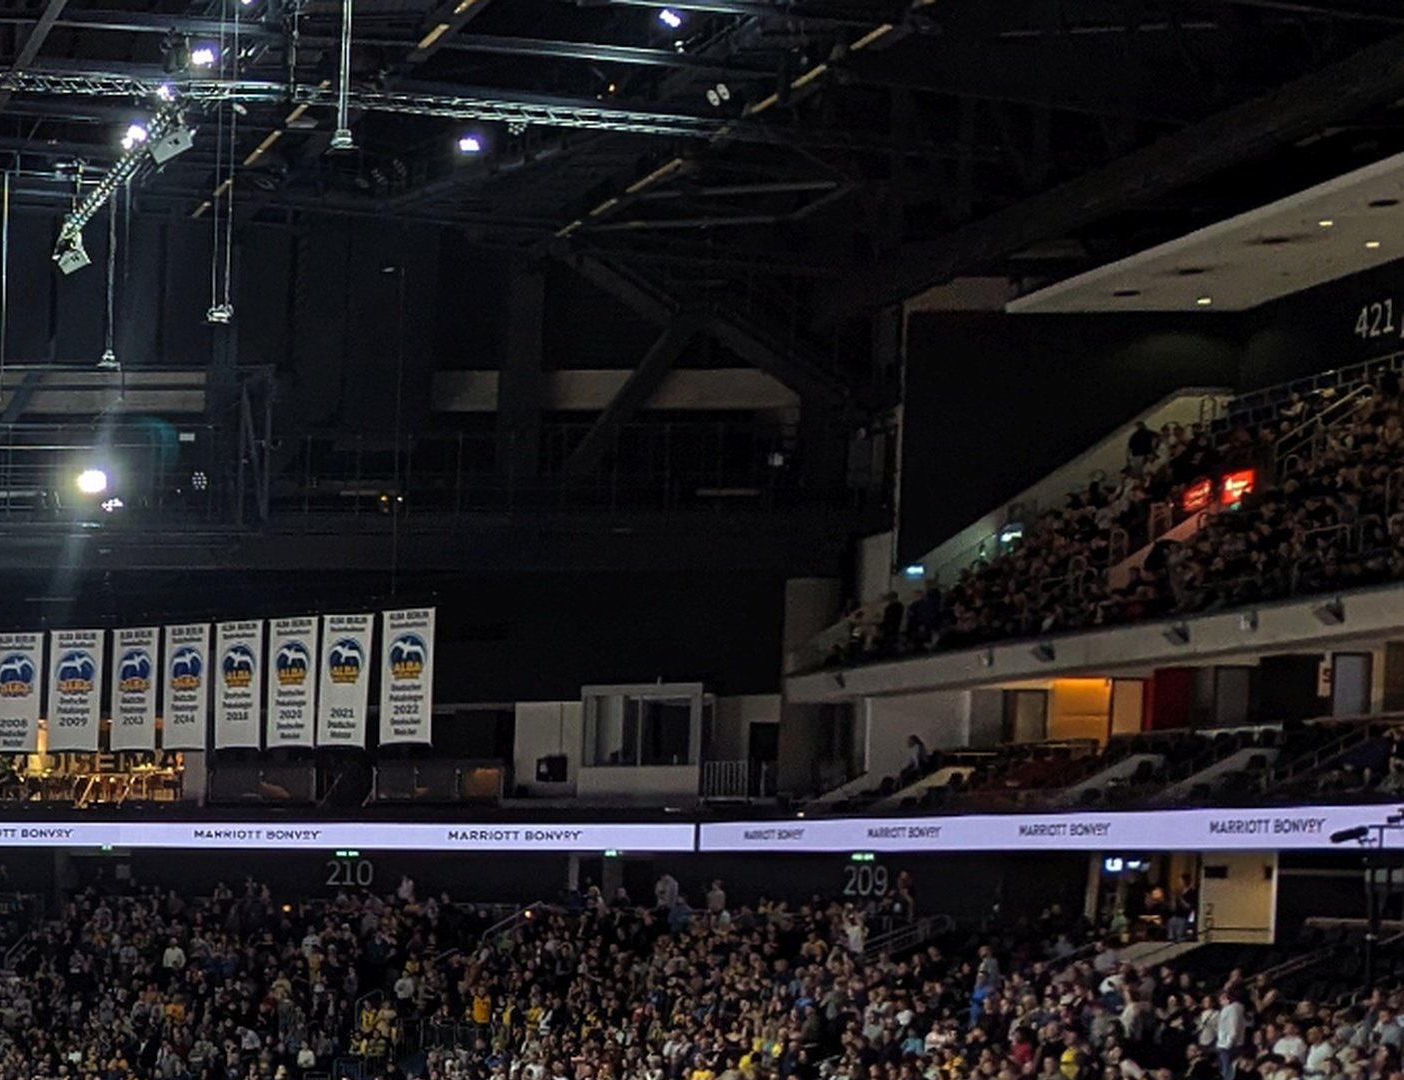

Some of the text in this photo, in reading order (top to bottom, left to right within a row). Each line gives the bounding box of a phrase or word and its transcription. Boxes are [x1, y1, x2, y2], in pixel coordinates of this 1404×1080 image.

[1354, 298, 1395, 338] 421
[330, 707, 355, 719] 2021
[393, 704, 420, 715] 2022
[58, 716, 88, 727] 2009
[1018, 822, 1112, 837] MARRIOTT BONVOY
[1209, 817, 1327, 835] MARRIOTT BONVOY
[193, 829, 263, 841] MARRIOTT
[447, 829, 521, 841] MARRIOTT
[867, 827, 907, 839] MARRIOTT
[325, 860, 374, 887] 210
[842, 864, 889, 897] 209
